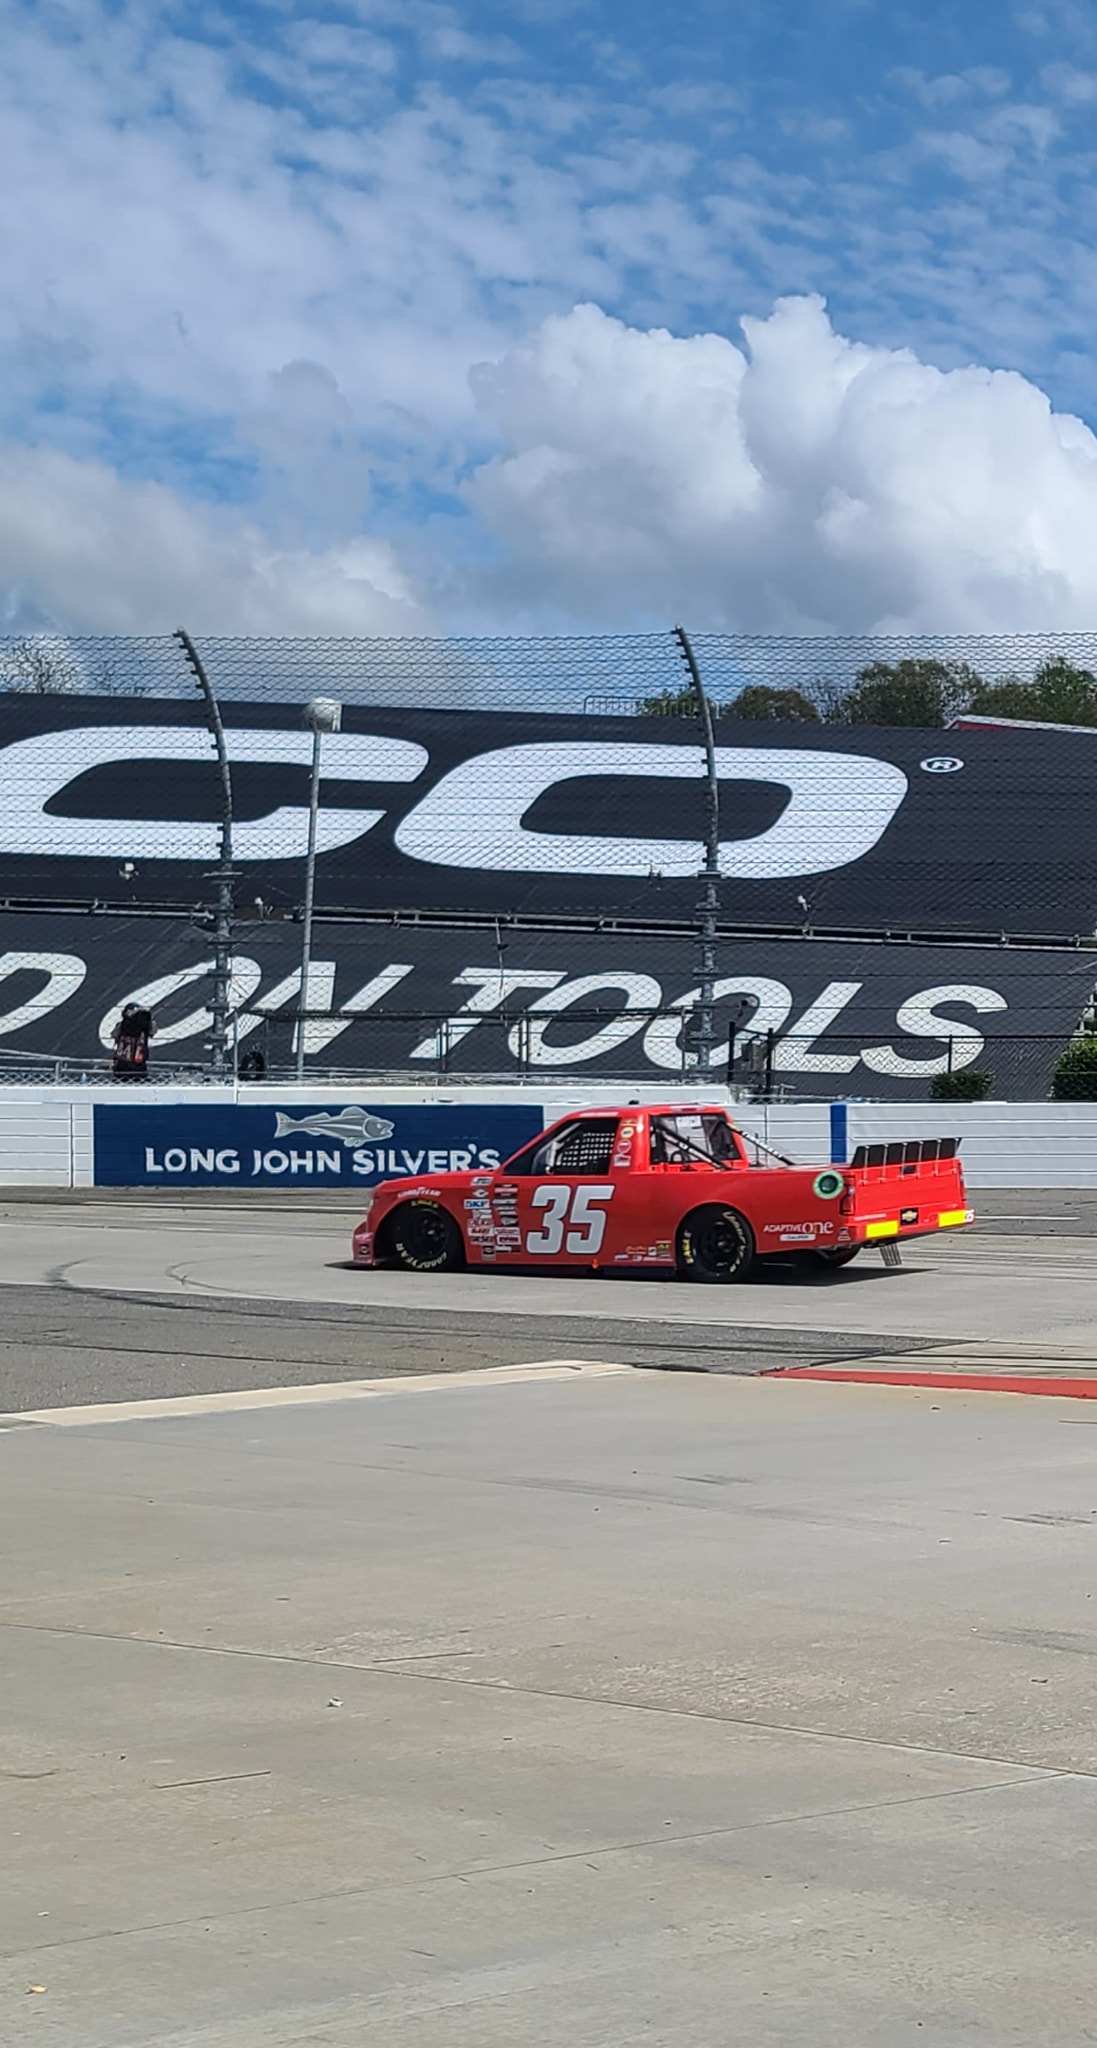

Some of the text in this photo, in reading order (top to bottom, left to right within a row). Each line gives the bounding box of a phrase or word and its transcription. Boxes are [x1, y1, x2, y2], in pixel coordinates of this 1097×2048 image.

[98, 955, 414, 1055] ON
[409, 966, 1009, 1079] TOOLS
[145, 1143, 501, 1176] LONG JOHN SILVER'S
[526, 1184, 615, 1255] 35
